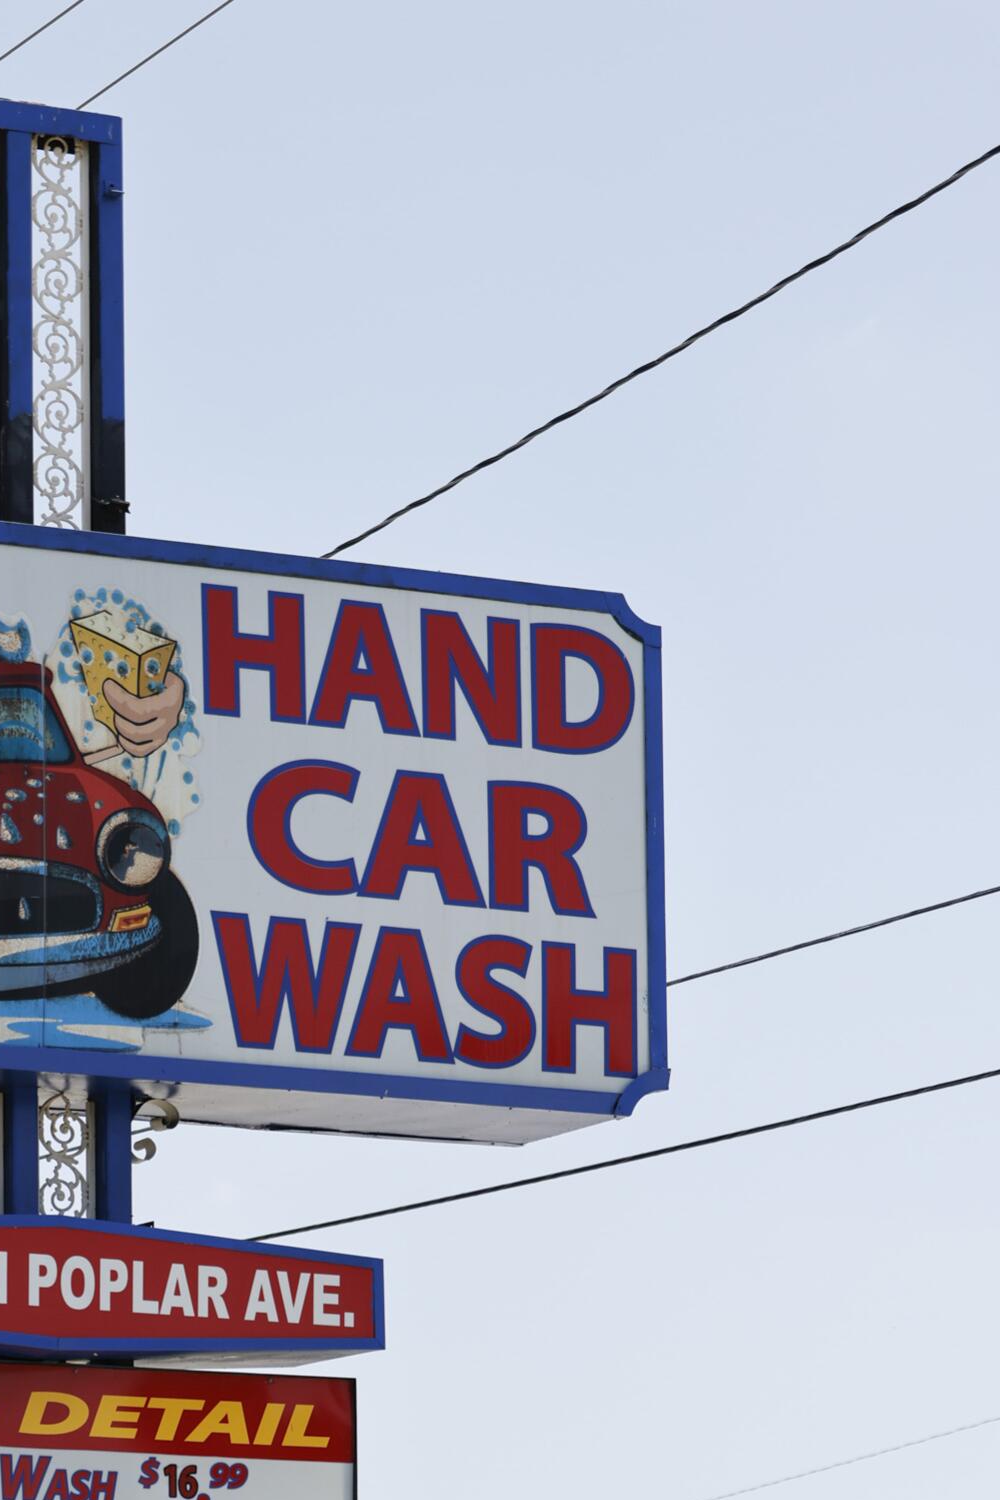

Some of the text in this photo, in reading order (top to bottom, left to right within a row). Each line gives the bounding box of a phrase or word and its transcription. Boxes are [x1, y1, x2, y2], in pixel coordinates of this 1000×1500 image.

[200, 581, 638, 756] HAND
[246, 758, 597, 920] CAR
[210, 911, 639, 1080] WASH
[27, 1252, 230, 1320] POPLAR
[243, 1269, 356, 1328] AVE.
[17, 1391, 331, 1449] DETAIL
